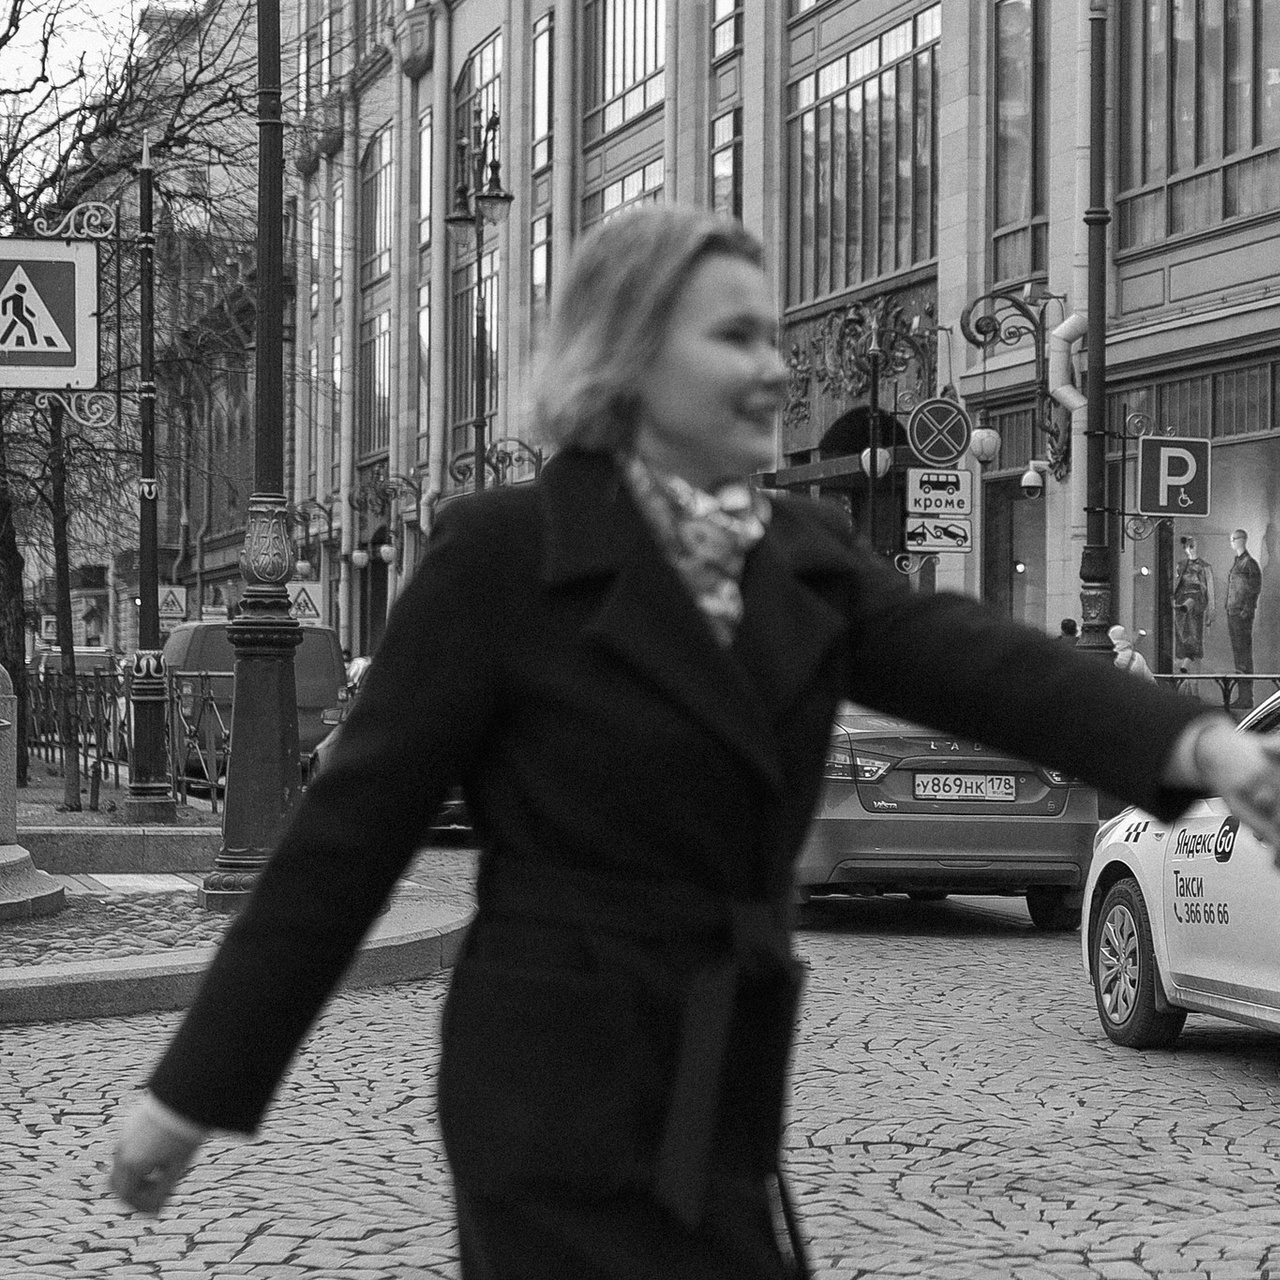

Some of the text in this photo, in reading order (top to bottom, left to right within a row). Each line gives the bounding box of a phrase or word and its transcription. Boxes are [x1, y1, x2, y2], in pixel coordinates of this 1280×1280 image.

[1160, 447, 1197, 506] P
[914, 498, 965, 510] кроме
[930, 741, 982, 751] LAD
[987, 777, 1010, 790] 178
[1174, 825, 1234, 858] Яндекс Go
[1173, 870, 1204, 897] Такси
[1184, 902, 1229, 924] 366 66 66
